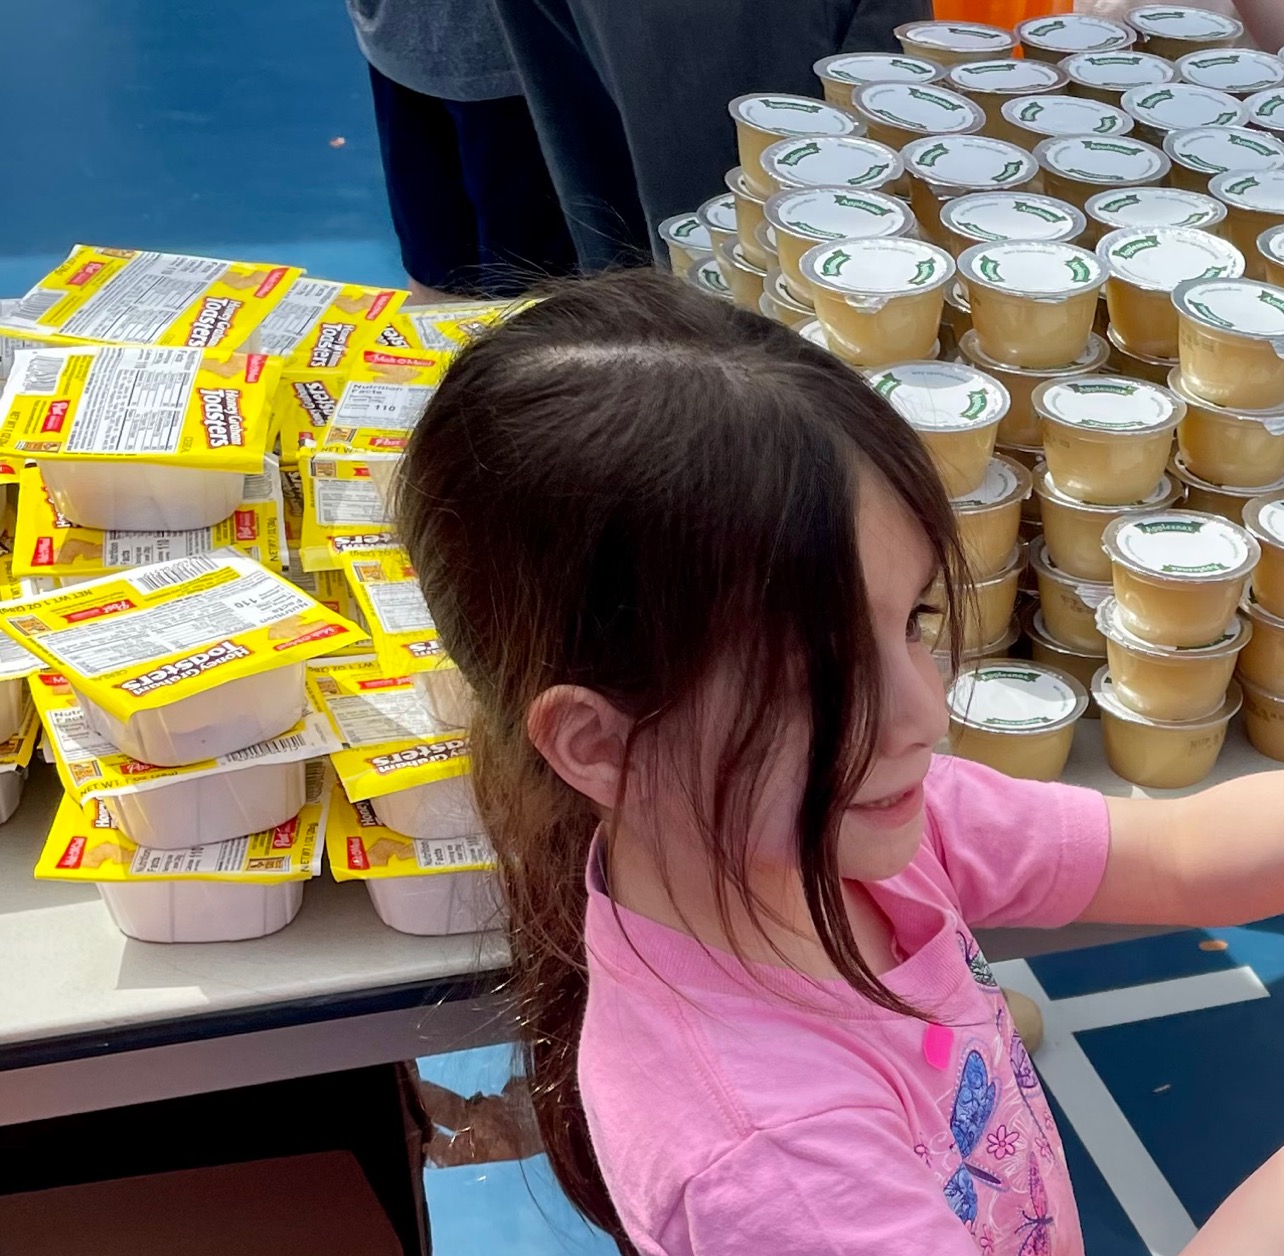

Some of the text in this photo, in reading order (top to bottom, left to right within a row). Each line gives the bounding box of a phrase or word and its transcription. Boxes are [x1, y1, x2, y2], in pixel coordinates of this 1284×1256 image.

[188, 298, 227, 347] Toasters
[310, 324, 338, 368] Toasters
[353, 384, 402, 392] Nutrition
[375, 404, 396, 412] 110
[200, 388, 228, 448] Toasters
[226, 388, 243, 446] Honey Graham
[51, 594, 69, 604] WT
[70, 589, 92, 602] NET
[234, 596, 258, 610] 110
[28, 600, 42, 609] OZ
[101, 601, 130, 614] Post
[259, 600, 307, 623] Nutrition
[120, 641, 241, 691] Toasters
[132, 647, 250, 695] Honey Graham
[80, 783, 100, 796] NET
[101, 779, 120, 790] WT
[356, 801, 376, 827] Honey
[420, 841, 432, 866] Nutrition
[434, 848, 444, 865] Facts
[300, 857, 312, 873] NET
